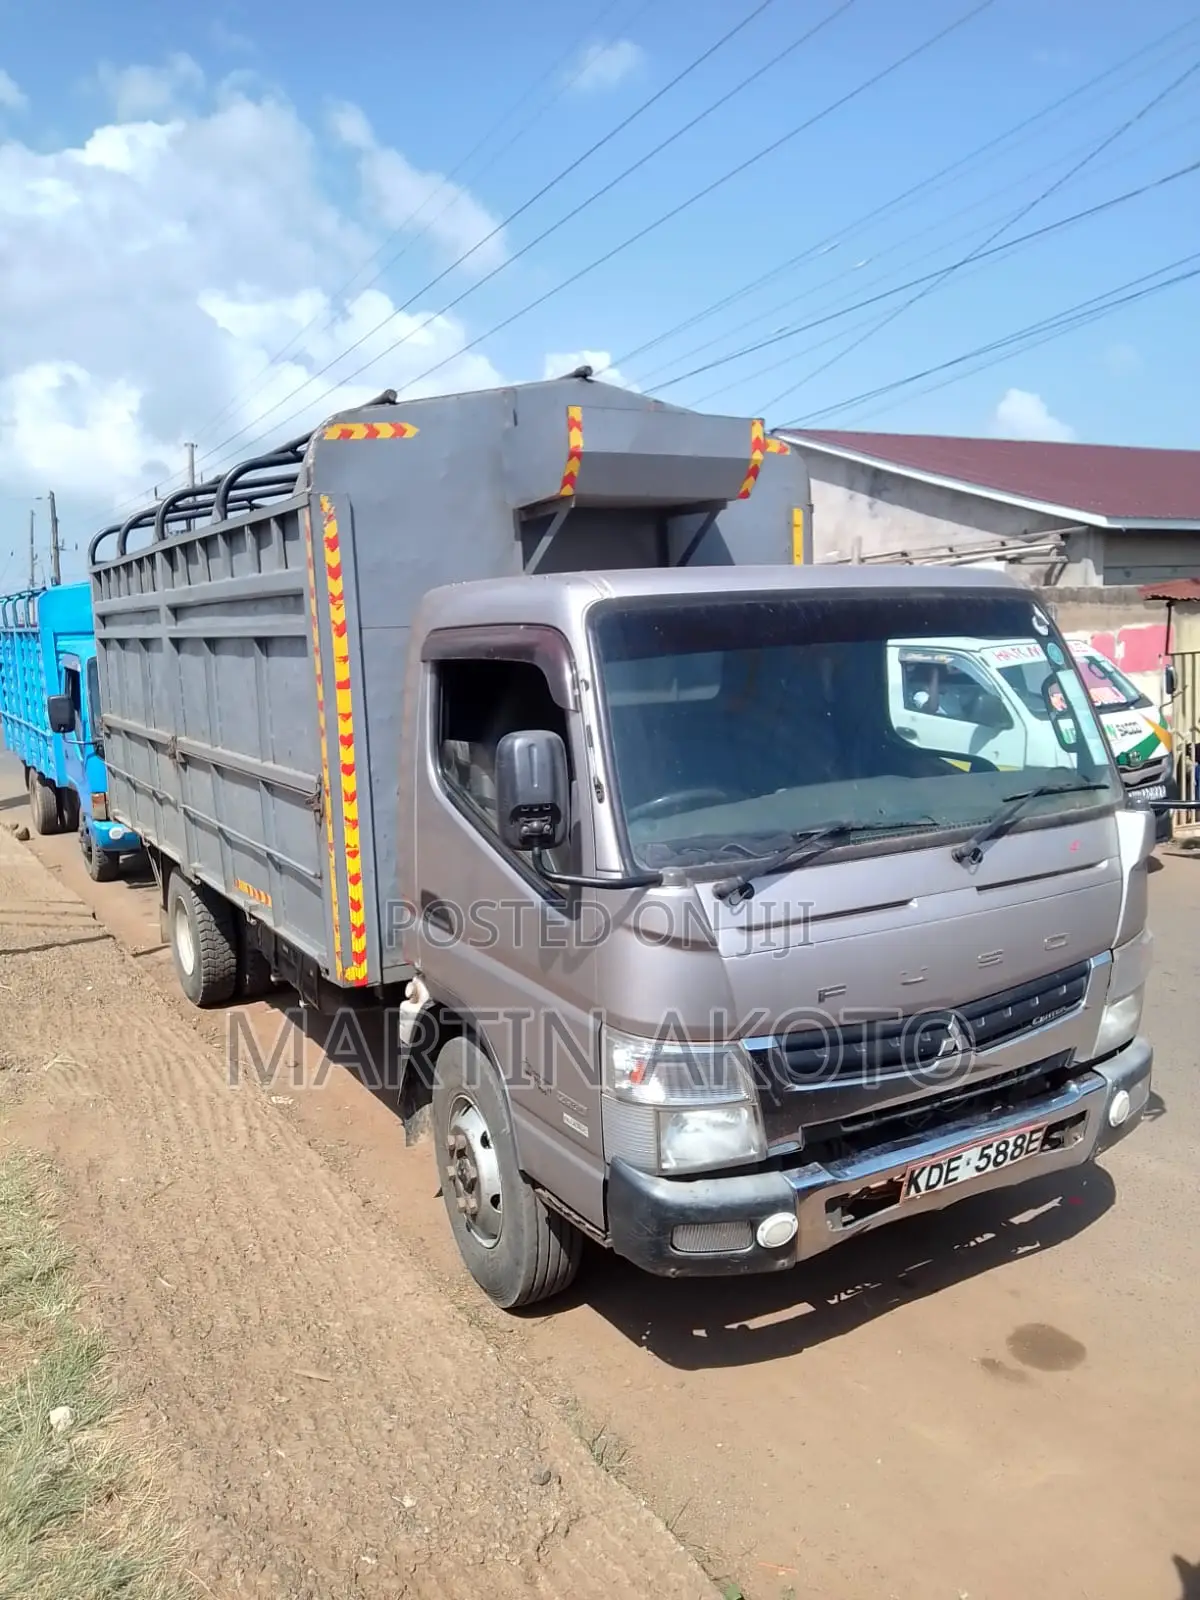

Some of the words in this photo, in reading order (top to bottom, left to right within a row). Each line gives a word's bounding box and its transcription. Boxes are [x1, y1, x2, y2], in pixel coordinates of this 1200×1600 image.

[817, 932, 1070, 1003] FUSO
[905, 1154, 964, 1197] KDE
[974, 1127, 1047, 1173] 588E
